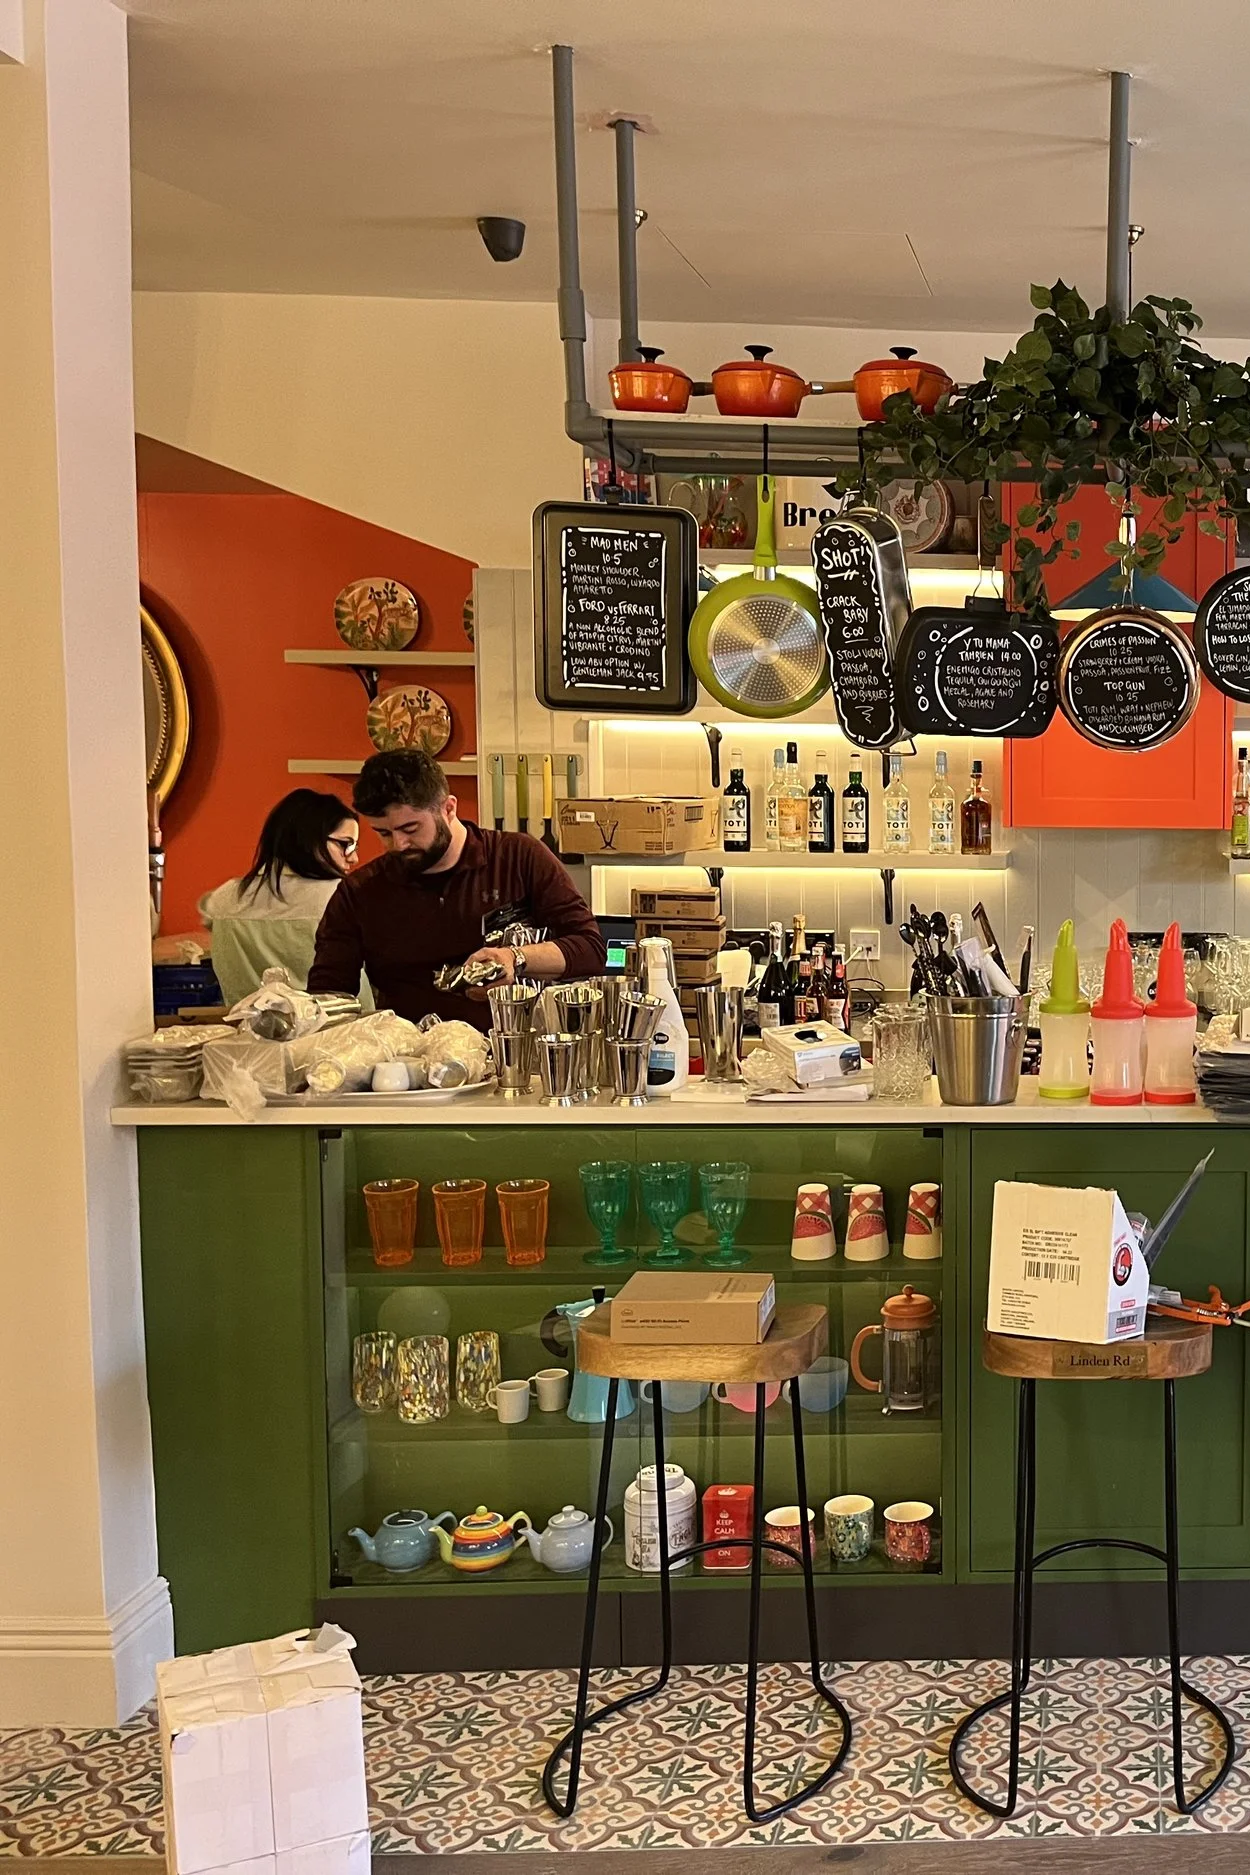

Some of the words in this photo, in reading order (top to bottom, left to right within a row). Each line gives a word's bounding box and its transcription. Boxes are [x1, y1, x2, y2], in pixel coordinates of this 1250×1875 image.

[591, 536, 610, 550] MAD
[614, 539, 638, 552] MEN
[821, 545, 866, 570] SHOT!
[571, 563, 599, 573] MONKEY
[572, 575, 602, 585] MARTINI
[827, 596, 861, 608] CRACK
[1231, 592, 1249, 602] THE
[579, 598, 605, 612] FORD
[619, 601, 655, 616] FERRARI
[843, 607, 869, 623] BABY
[636, 627, 659, 636] BLEND
[964, 638, 971, 650] Y
[973, 638, 982, 648] TU
[986, 638, 1011, 649] MAMA
[1089, 637, 1117, 648] CRIMES
[1118, 637, 1126, 645] OF
[1127, 636, 1156, 645] PASSION
[1212, 635, 1227, 646] HOW
[1229, 635, 1237, 644] TO
[569, 642, 606, 652] VIBRANTE
[571, 657, 586, 666] LOW
[588, 658, 603, 666] ABV
[604, 658, 630, 667] OPTION
[958, 651, 994, 662] TAMBIEN
[573, 666, 612, 677] GENTLEMAN
[616, 669, 636, 679] JACK
[947, 665, 980, 675] ENEMIGO
[1104, 681, 1124, 690] TOP
[1125, 680, 1146, 691] GUN
[842, 689, 858, 700] AND
[859, 689, 888, 702] BUBBLES
[998, 689, 1013, 698] AND
[958, 698, 995, 709] ROSEMARY
[1070, 1355, 1109, 1366] Linden
[1113, 1355, 1130, 1366] Rd
